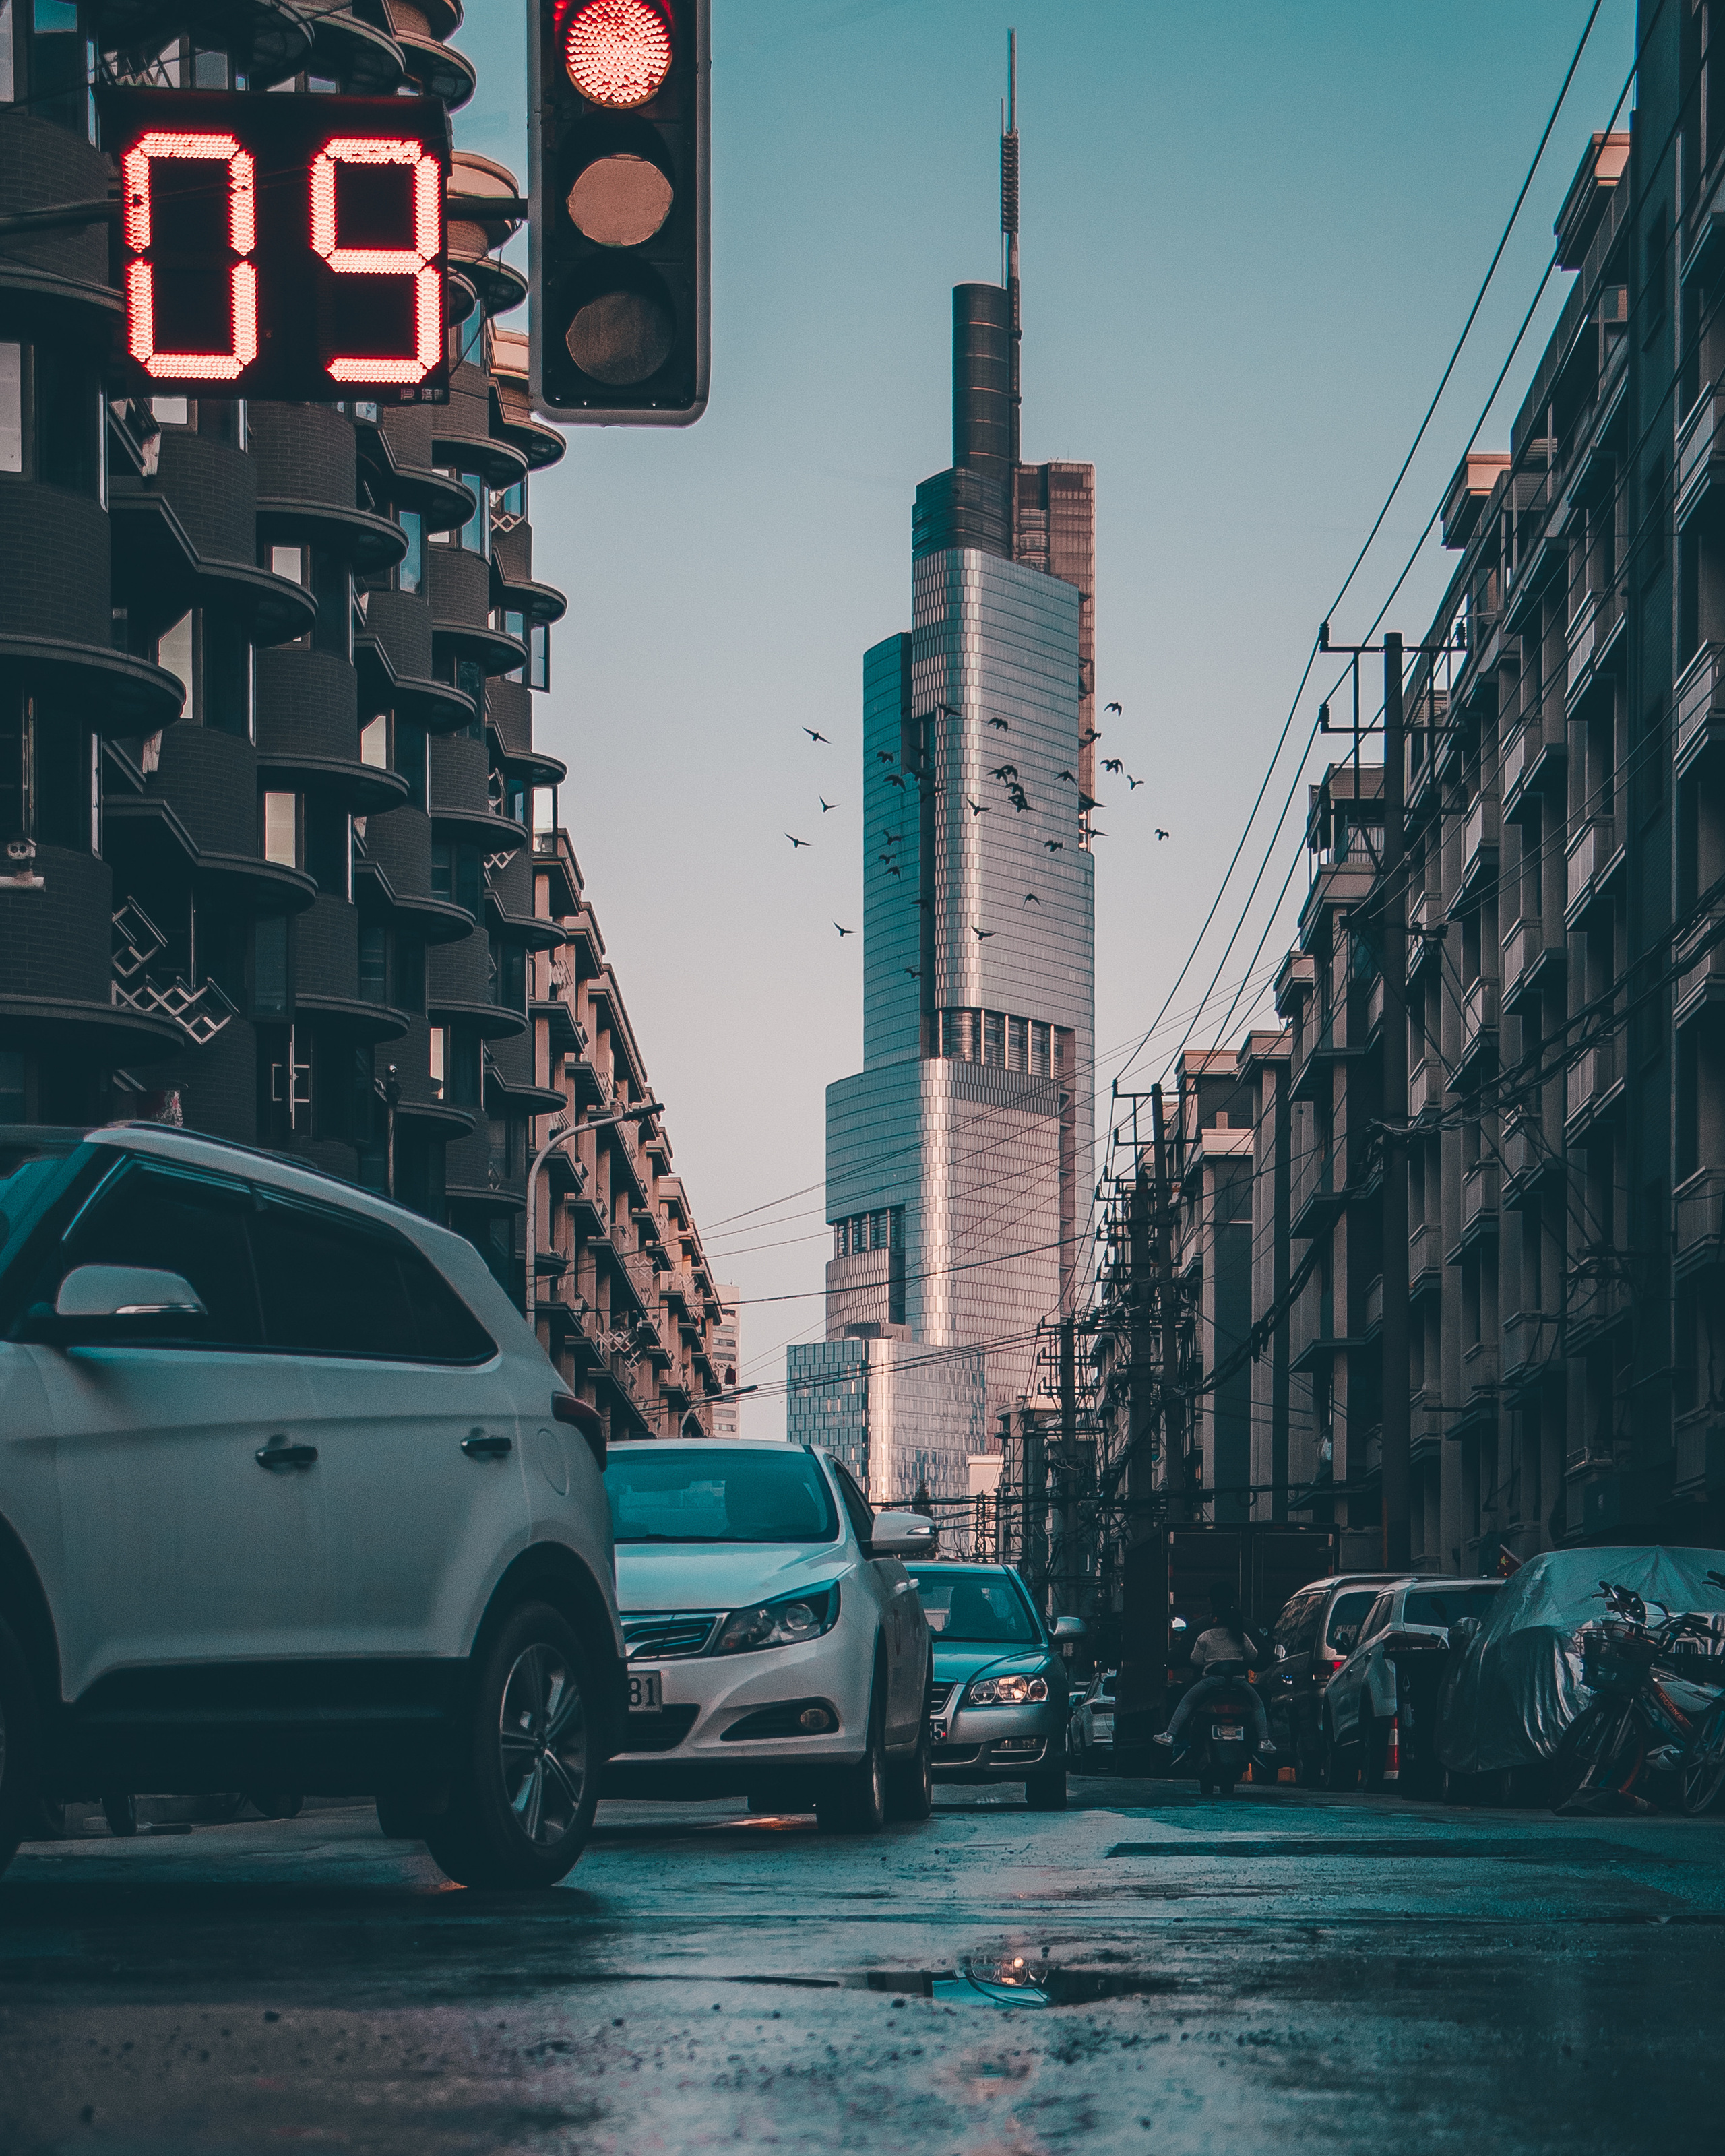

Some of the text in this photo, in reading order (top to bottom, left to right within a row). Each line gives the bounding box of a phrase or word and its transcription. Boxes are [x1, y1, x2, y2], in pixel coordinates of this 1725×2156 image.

[122, 131, 443, 383] 09
[627, 1677, 656, 1706] 81
[930, 1722, 943, 1740] 5
